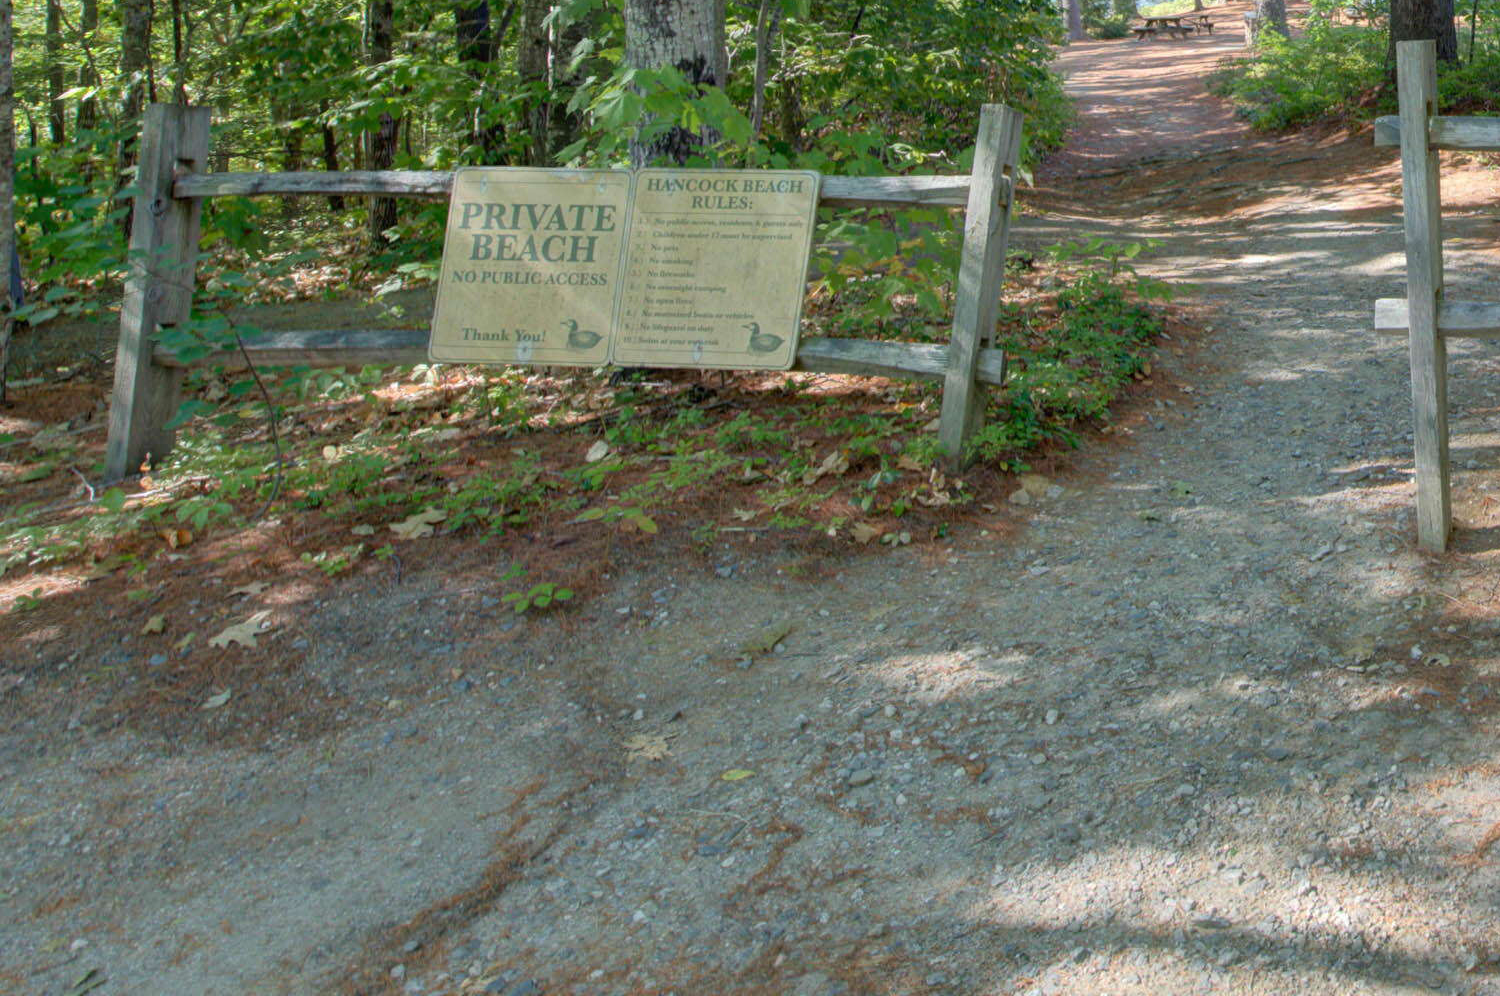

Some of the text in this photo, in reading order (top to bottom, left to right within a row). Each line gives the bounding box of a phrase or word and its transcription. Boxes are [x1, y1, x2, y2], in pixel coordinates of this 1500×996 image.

[647, 178, 803, 194] HANCOCK BEACH
[691, 195, 753, 210] RULES:
[458, 202, 616, 232] PRIVATE
[469, 233, 599, 263] BEACH
[451, 270, 608, 286] NO PUBLIC ACCESS
[462, 328, 546, 343] Thank You!
